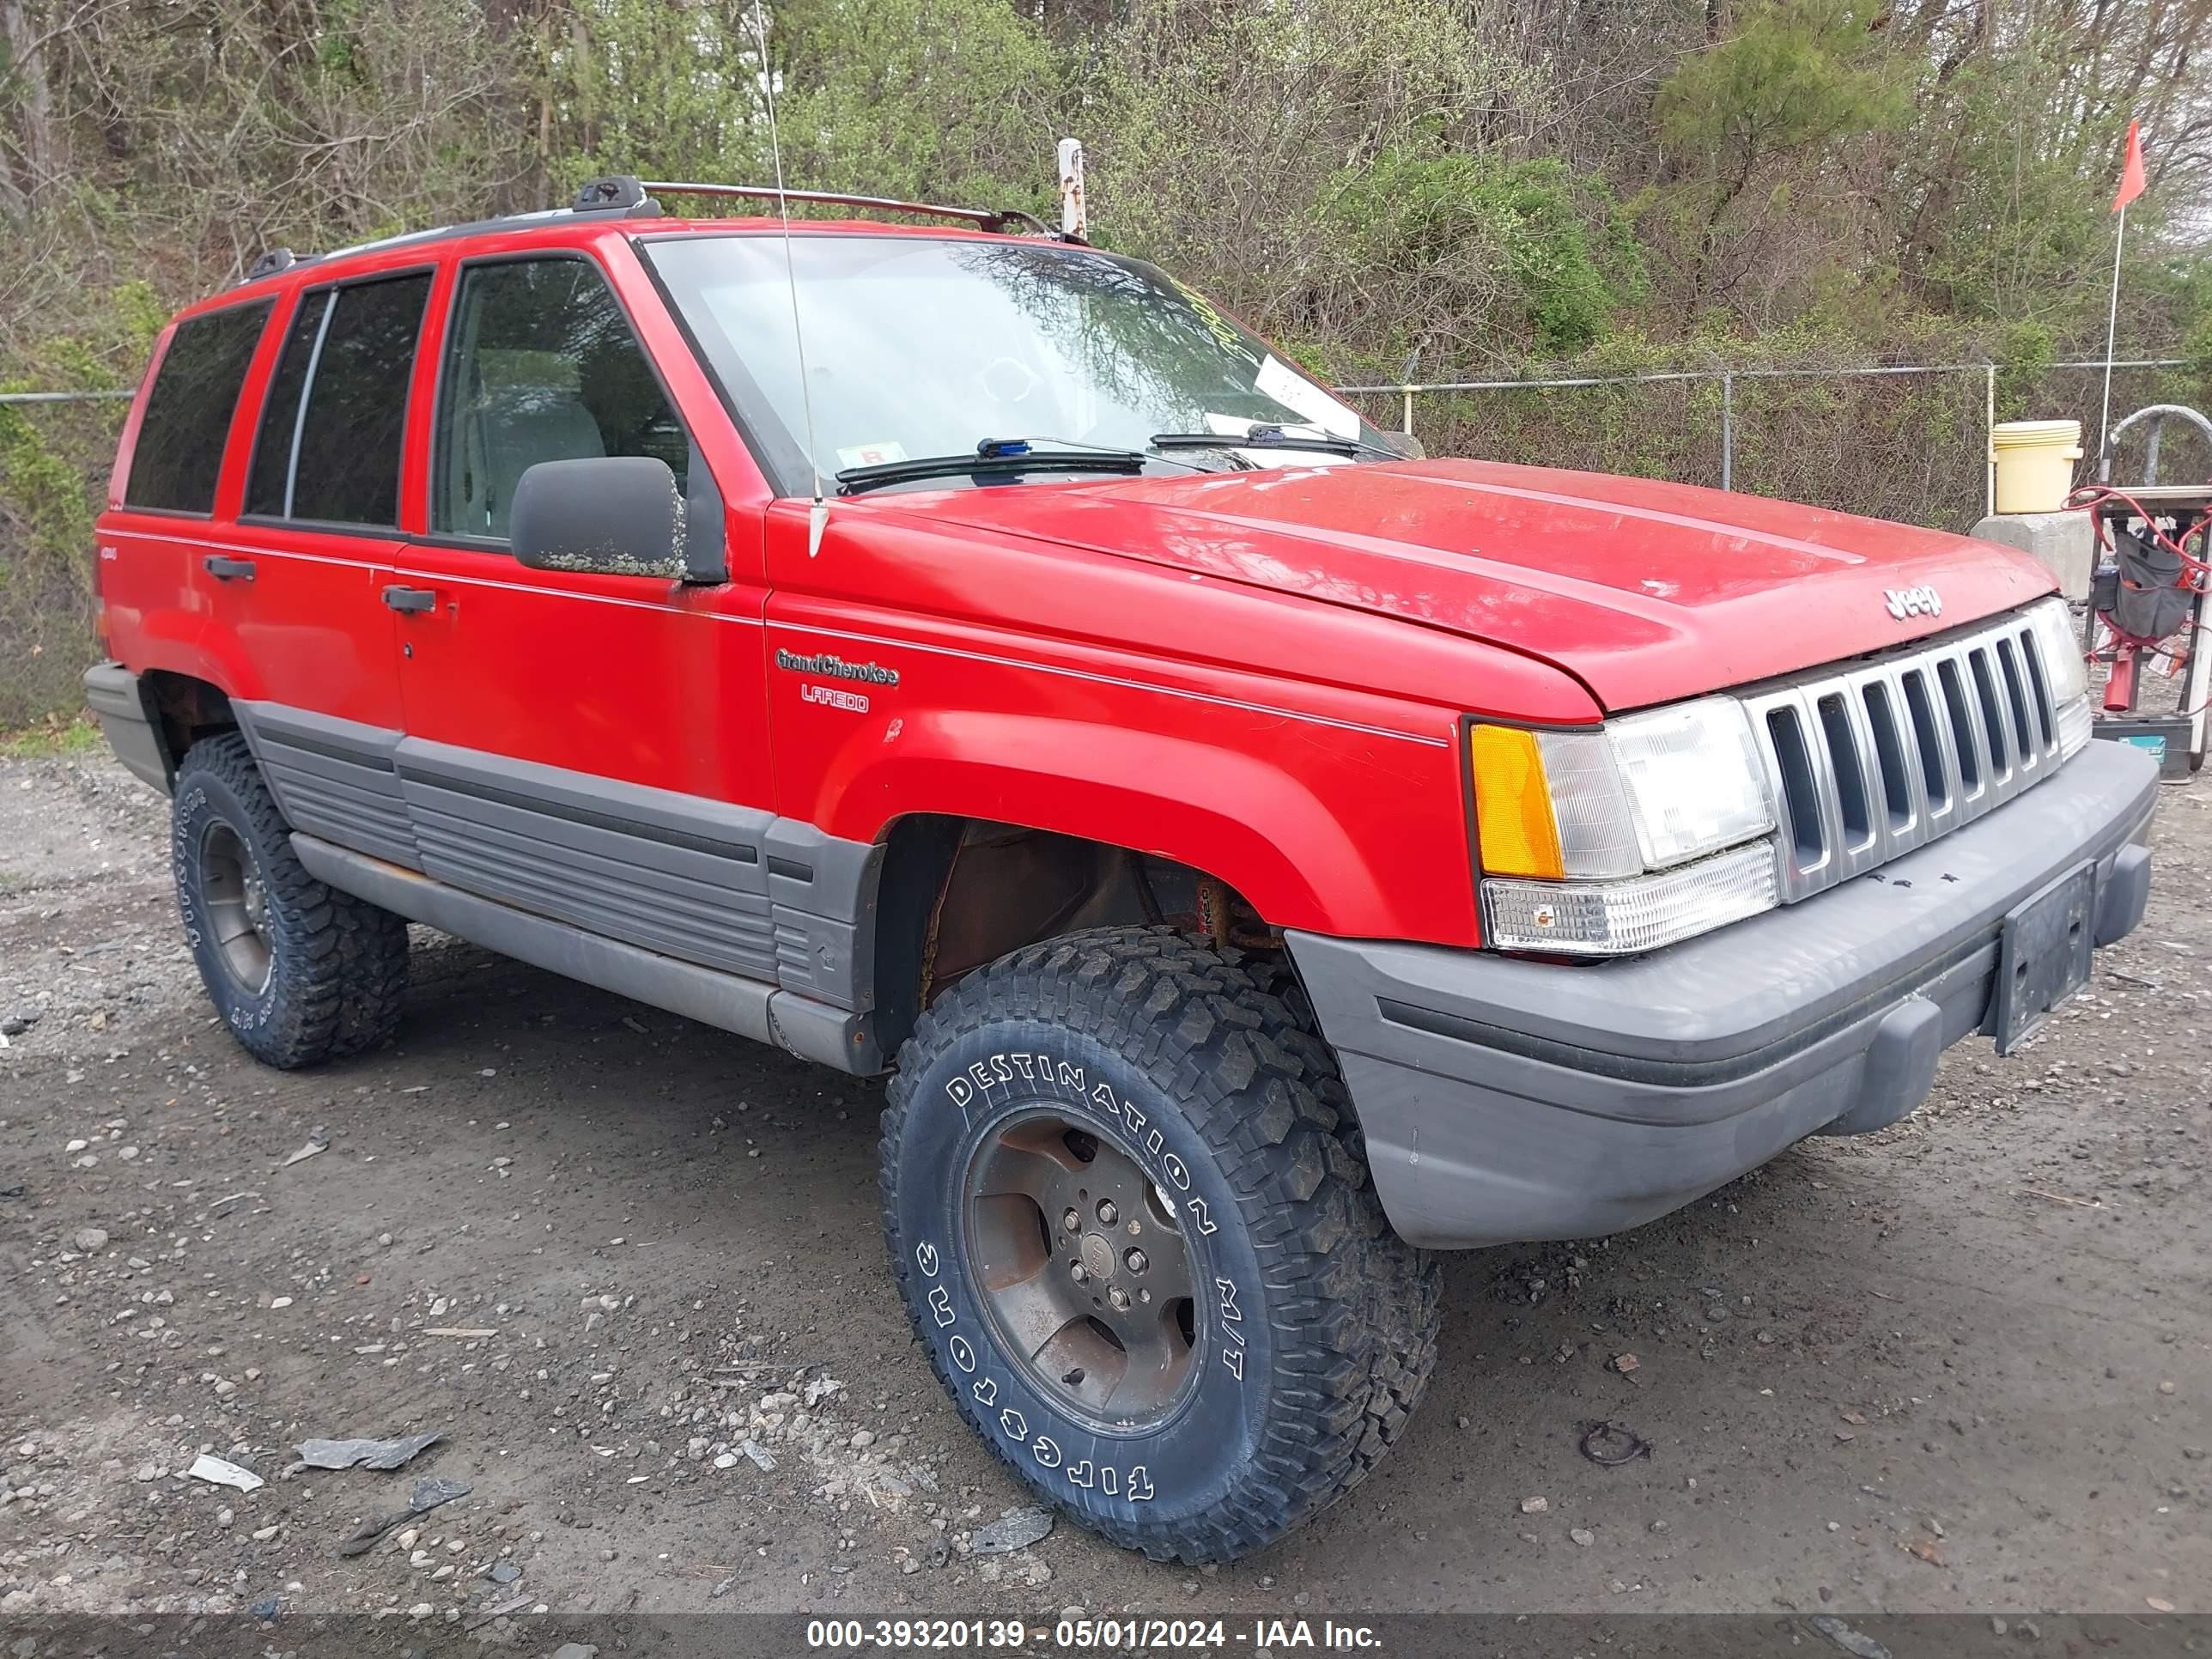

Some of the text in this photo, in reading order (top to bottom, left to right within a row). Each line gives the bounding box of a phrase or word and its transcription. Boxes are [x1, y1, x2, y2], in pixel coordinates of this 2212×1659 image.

[1882, 586, 1942, 621] Jeep
[801, 684, 870, 714] LAREDO
[945, 1054, 1245, 1381] DESTINATION M/T
